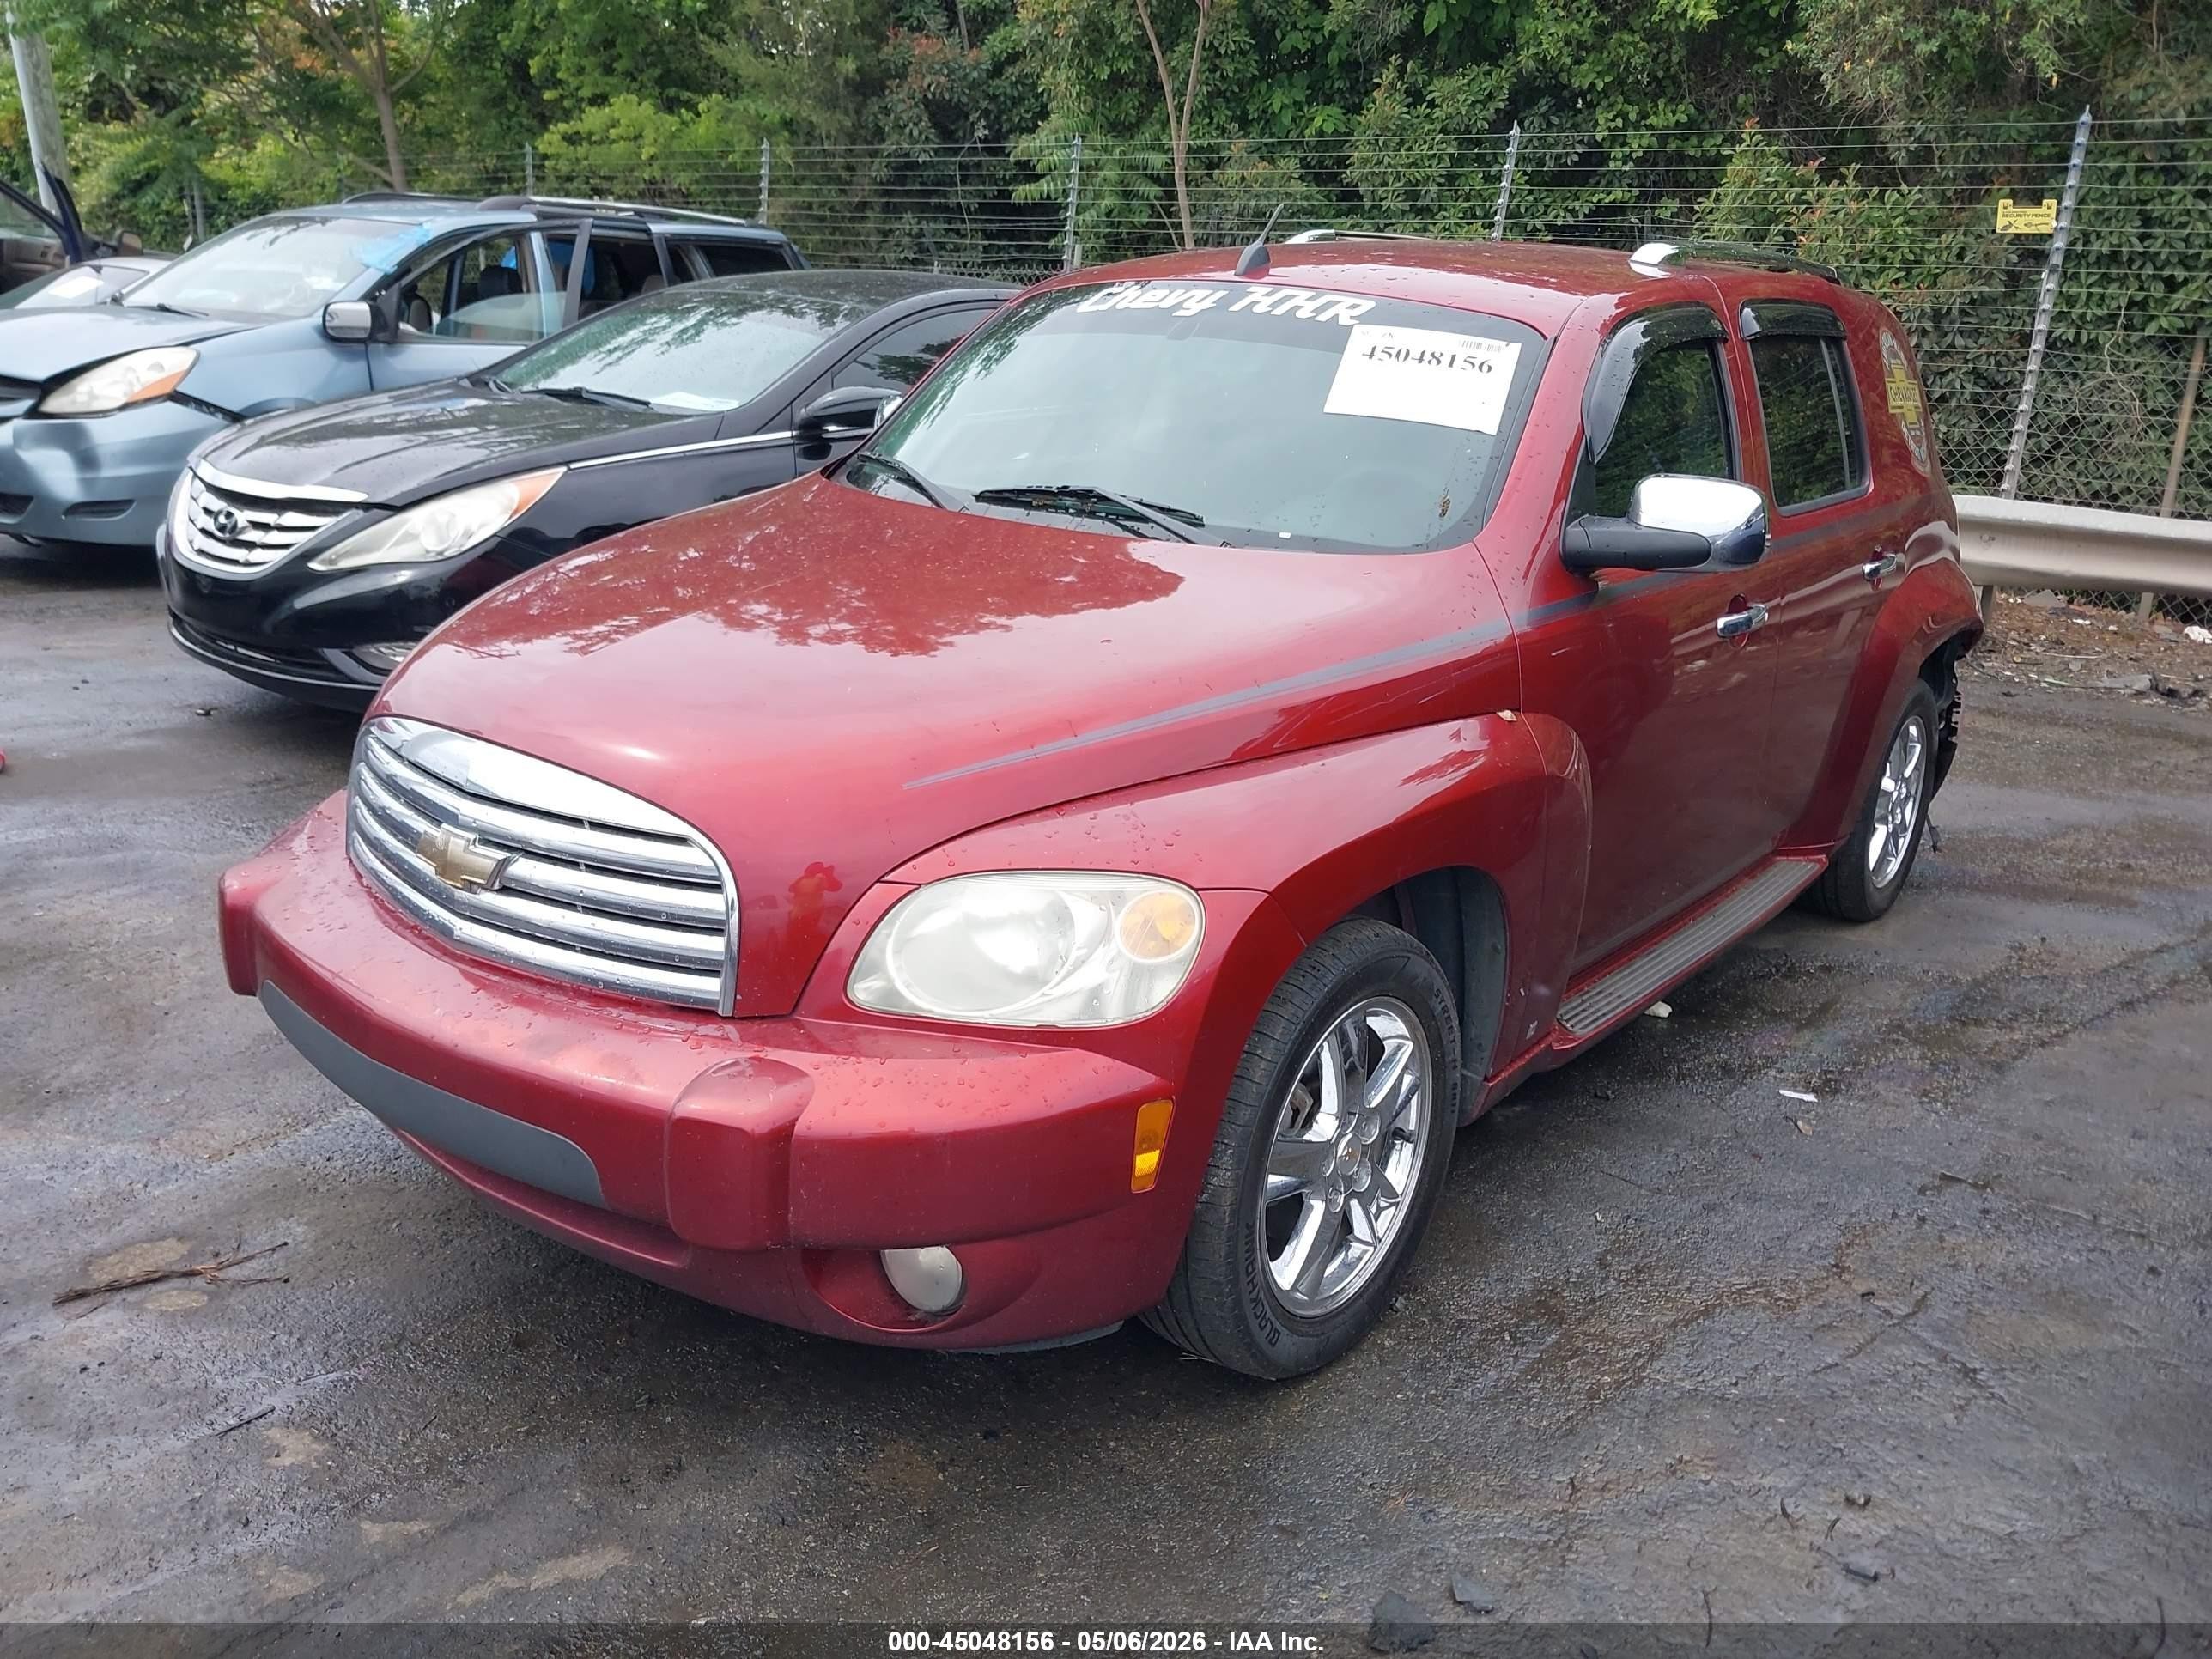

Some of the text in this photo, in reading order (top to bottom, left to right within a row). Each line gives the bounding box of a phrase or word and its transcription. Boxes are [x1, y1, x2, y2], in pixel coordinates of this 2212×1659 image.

[1076, 285, 1376, 325] Chevy HHR
[1361, 344, 1493, 374] 45048156
